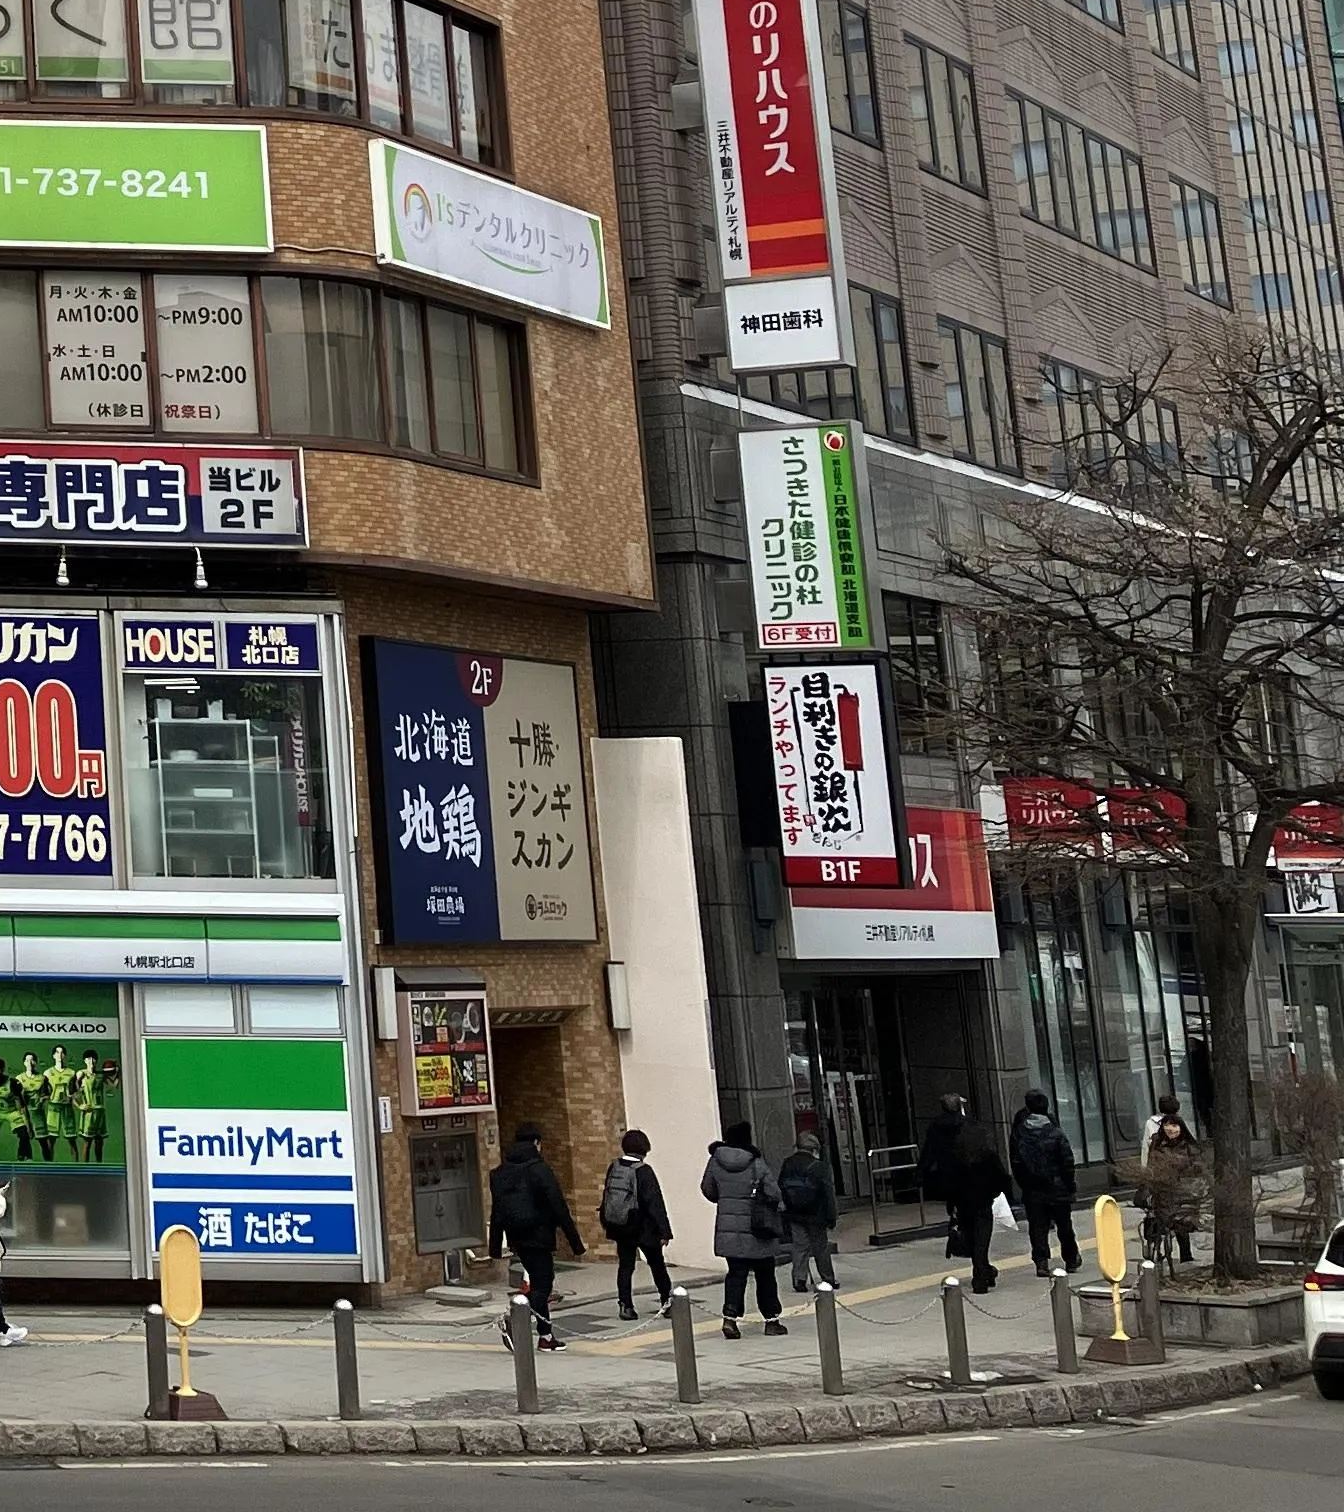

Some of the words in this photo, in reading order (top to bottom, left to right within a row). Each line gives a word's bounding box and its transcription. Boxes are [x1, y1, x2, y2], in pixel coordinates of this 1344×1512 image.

[56, 304, 140, 325] AM10:00
[740, 308, 824, 335] 神田歯科
[59, 363, 143, 383] AM10:00
[208, 466, 282, 494] 当ビル
[219, 498, 278, 531] 2F
[781, 436, 823, 606] さつきた健診の杜
[761, 518, 794, 621] クリニック
[124, 627, 216, 663] HOUSE
[248, 625, 288, 647] 札幌
[767, 625, 833, 642] 6F受付
[240, 645, 300, 666] 北口店
[469, 659, 493, 697] 2F
[393, 708, 475, 768] 北海道
[800, 671, 853, 834] 目利きの銀次
[768, 675, 804, 846] ランチやってます
[507, 779, 572, 823] ジンギ
[399, 783, 483, 869] 地鶏
[511, 829, 575, 871] スカン
[820, 860, 861, 883] B1F
[123, 955, 196, 970] 札幌駅北口店
[22, 1022, 108, 1035] HOKKAIDO
[157, 1124, 344, 1167] FamilyMart
[198, 1206, 233, 1248] 酒
[243, 1211, 315, 1245] たばこ
